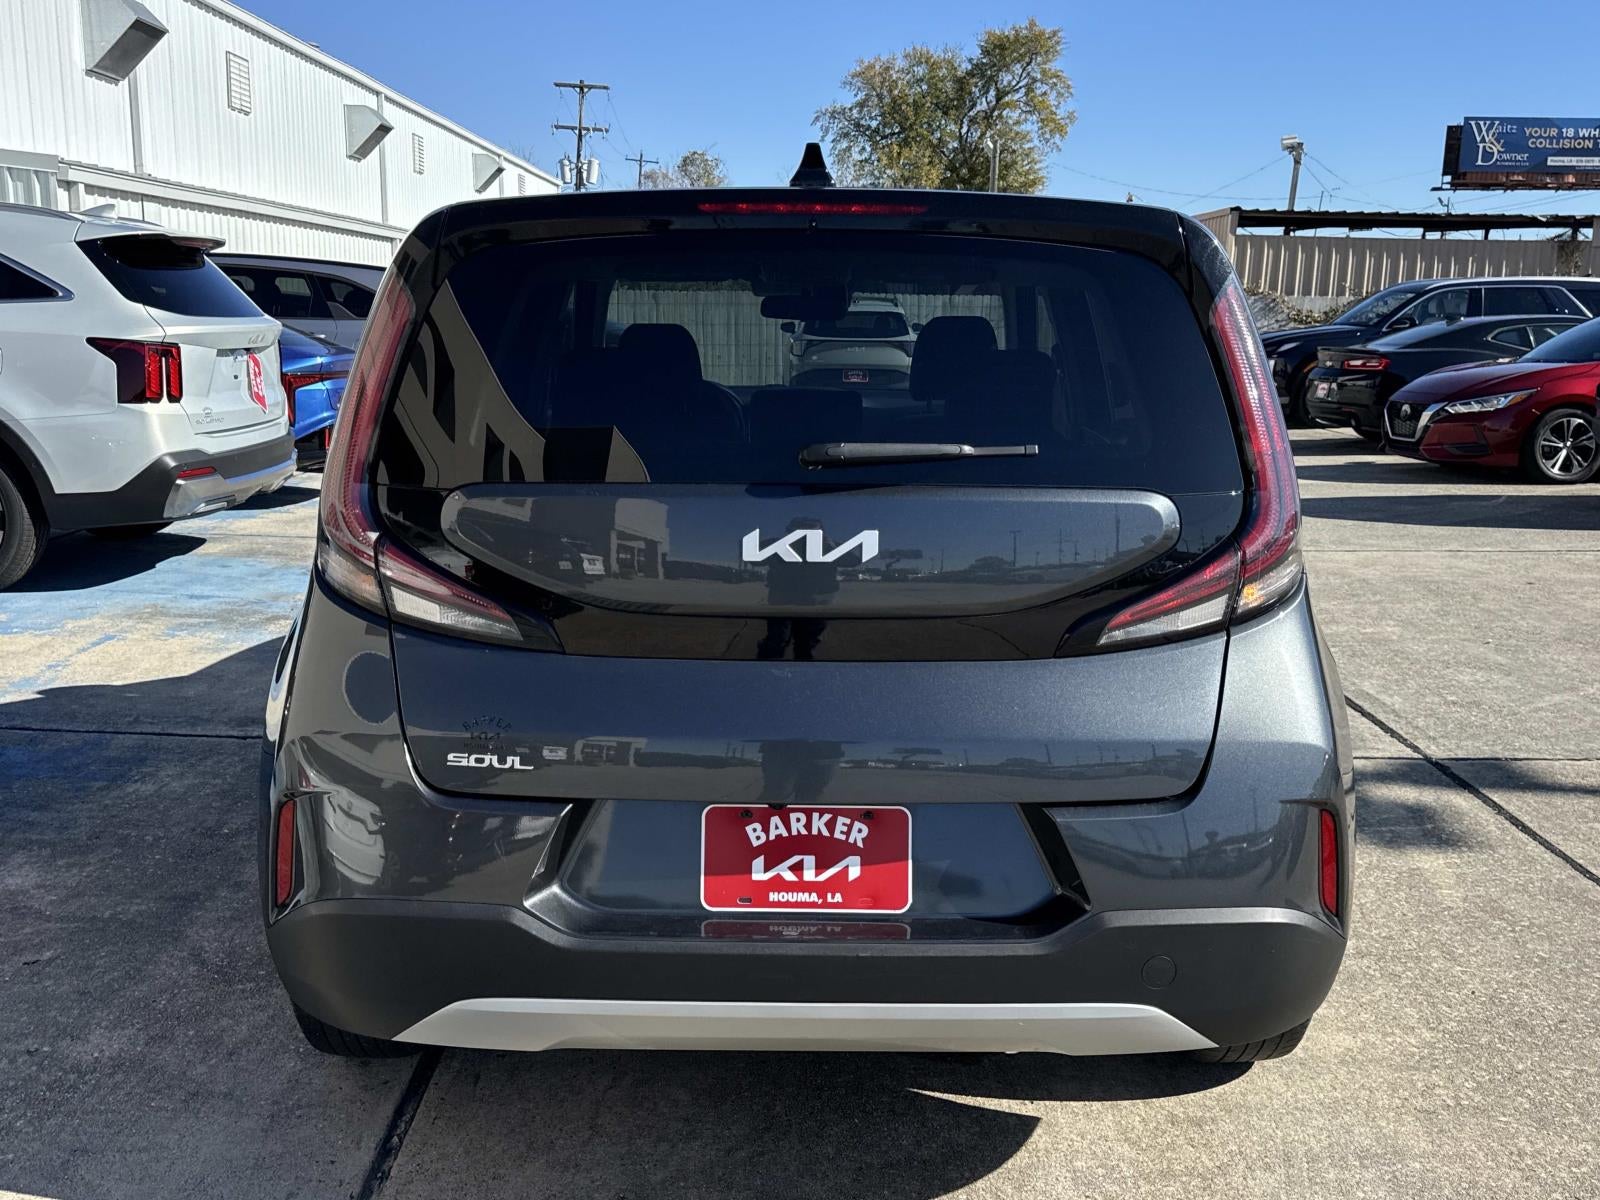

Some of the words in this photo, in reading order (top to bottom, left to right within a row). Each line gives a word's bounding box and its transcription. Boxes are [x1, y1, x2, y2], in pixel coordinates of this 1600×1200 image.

[1524, 127, 1558, 137] YOUR
[1561, 127, 1575, 138] 18
[1578, 128, 1600, 138] WH
[1475, 142, 1529, 166] Downer
[1528, 138, 1594, 149] COLLISION
[742, 528, 879, 563] KIA
[446, 752, 534, 770] SOUL
[745, 811, 869, 848] BARKER
[751, 855, 861, 882] KIA
[768, 891, 824, 905] HOUMA,
[827, 892, 843, 903] LA
